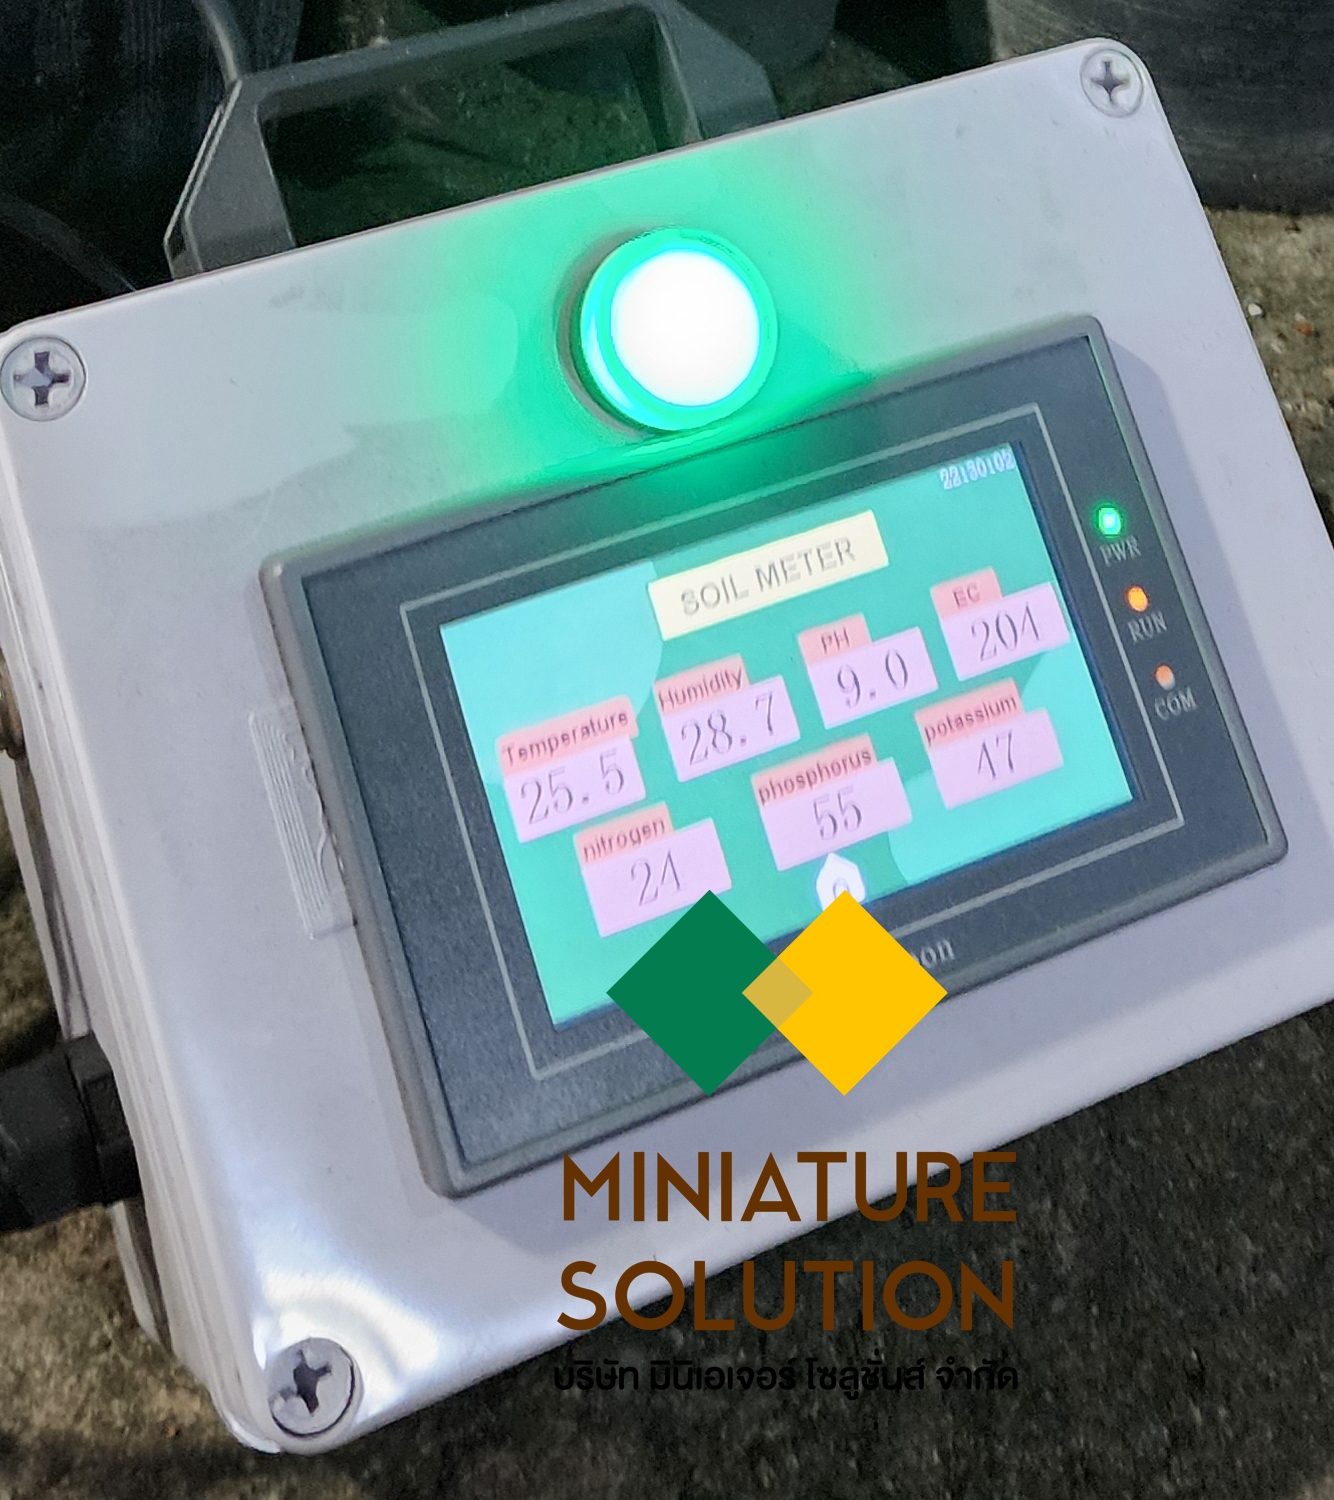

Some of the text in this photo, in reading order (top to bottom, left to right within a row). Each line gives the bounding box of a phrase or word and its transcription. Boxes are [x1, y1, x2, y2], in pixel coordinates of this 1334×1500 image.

[681, 537, 856, 616] SOIL METER
[1098, 534, 1142, 567] PWR
[953, 583, 981, 609] EC
[820, 627, 851, 655] PH
[1127, 611, 1168, 645] RUN
[658, 665, 743, 712] Humidity
[836, 649, 909, 709] 9.0
[1153, 687, 1198, 721] COM
[503, 710, 629, 768] Temperature
[680, 691, 775, 766] 28.7
[923, 695, 1018, 747] potassium
[520, 748, 626, 826] 25.5
[757, 748, 873, 807] phosphorus
[812, 785, 864, 842] 55
[582, 817, 666, 864] nitrogen
